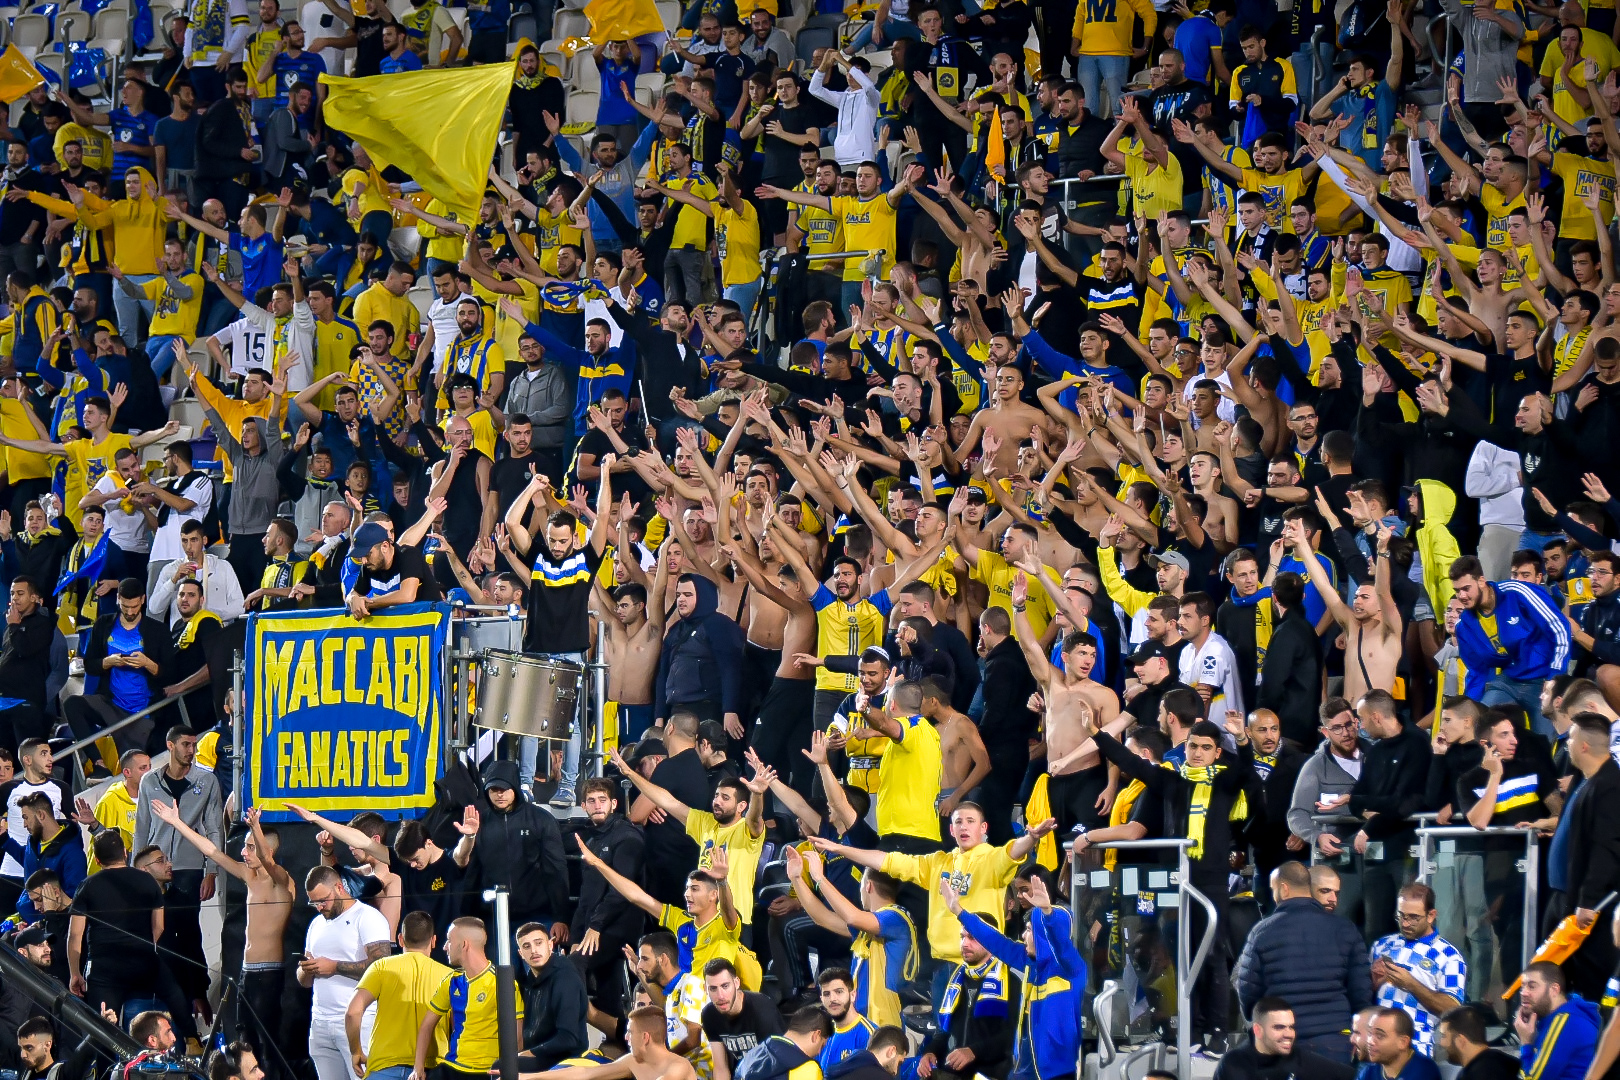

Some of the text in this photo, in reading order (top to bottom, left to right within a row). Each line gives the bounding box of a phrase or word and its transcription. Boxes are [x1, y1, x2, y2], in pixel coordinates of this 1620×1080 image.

[1086, 0, 1117, 23] M
[243, 332, 266, 362] 15
[265, 635, 430, 737] MACCABI
[277, 728, 410, 788] FANATICS
